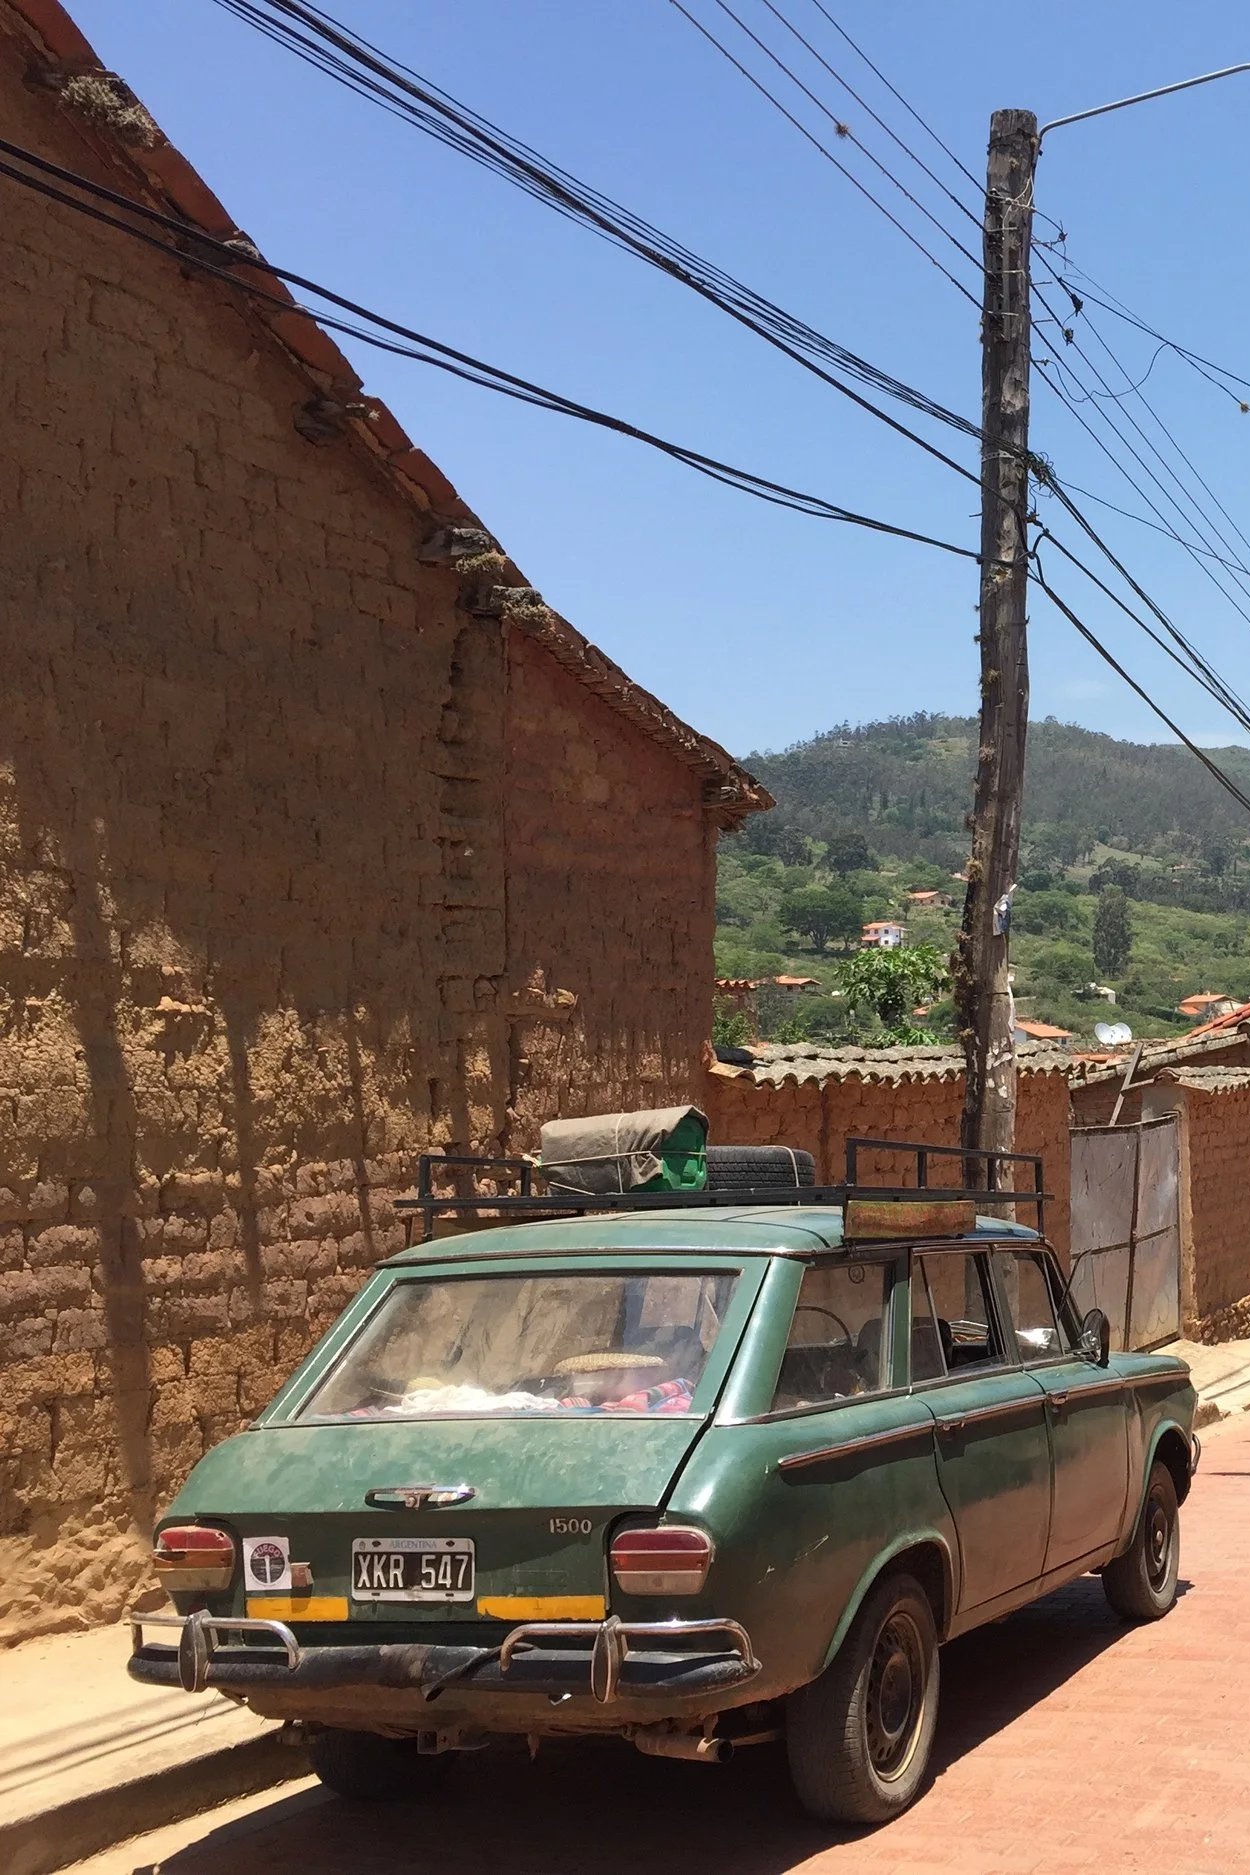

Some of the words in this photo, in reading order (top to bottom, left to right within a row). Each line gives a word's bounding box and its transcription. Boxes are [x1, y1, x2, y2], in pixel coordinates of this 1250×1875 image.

[550, 1518, 592, 1534] 1500
[390, 1540, 437, 1549] ARGENTINA
[357, 1554, 405, 1588] XKR
[421, 1554, 469, 1589] 547
